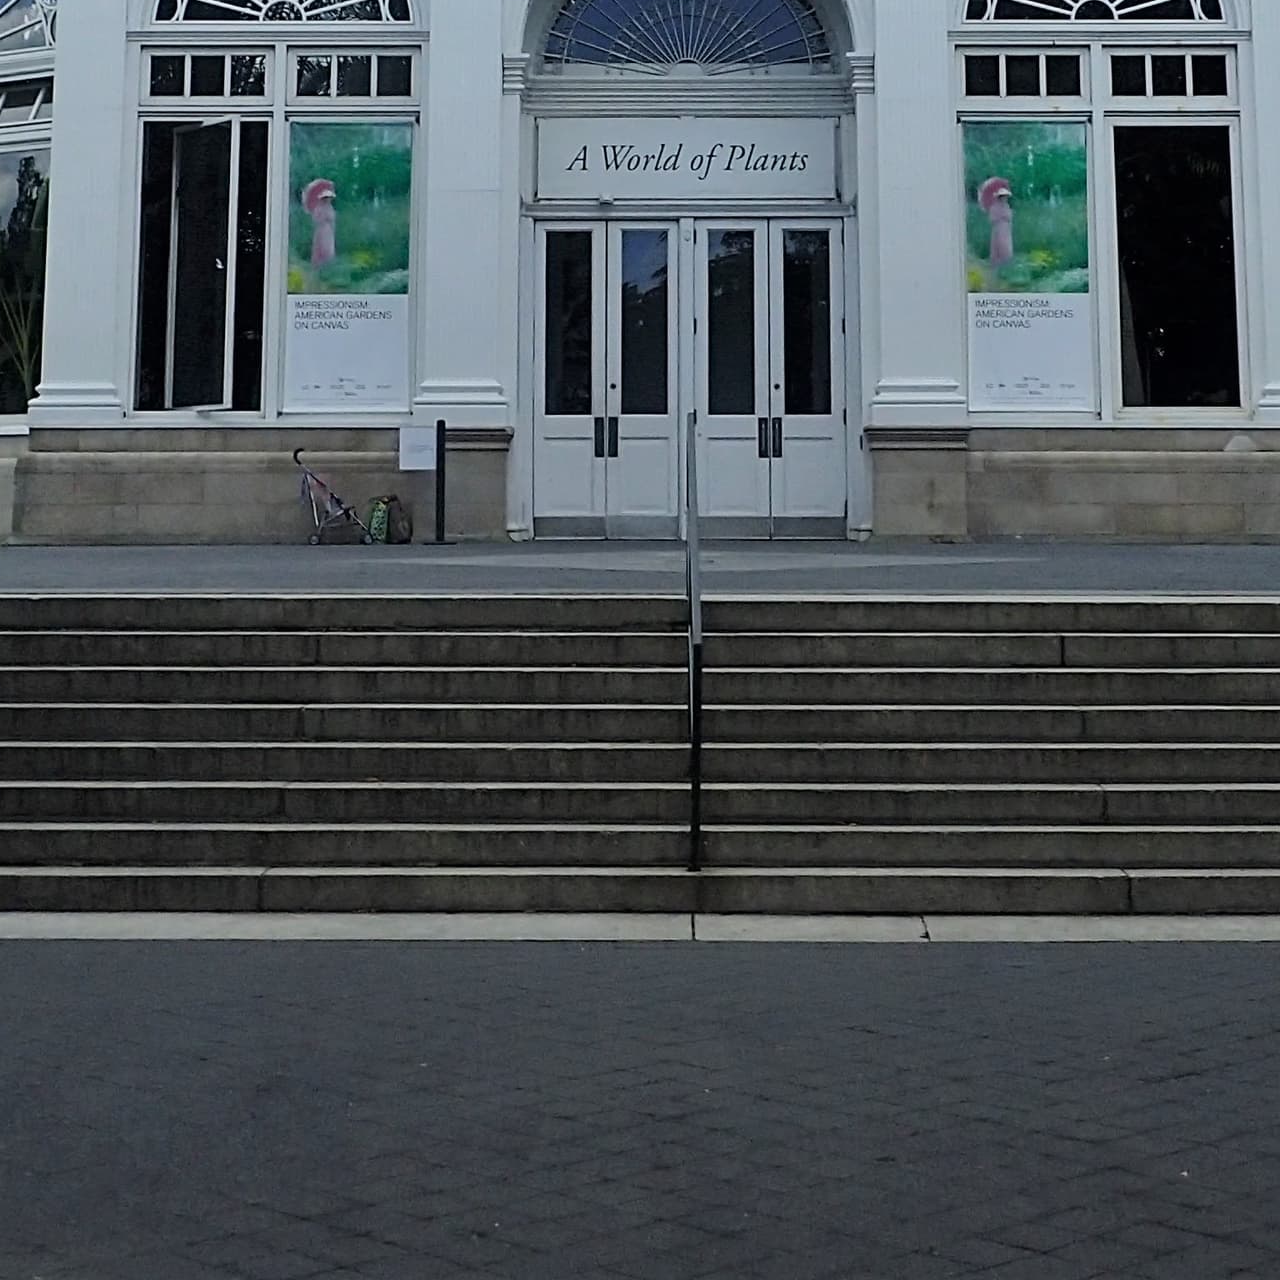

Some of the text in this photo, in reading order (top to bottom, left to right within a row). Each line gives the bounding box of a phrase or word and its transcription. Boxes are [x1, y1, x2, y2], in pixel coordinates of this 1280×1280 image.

[565, 143, 809, 180] A World of Plants
[294, 310, 393, 320] AMERICAN GARDENS
[975, 309, 1074, 319] AMERICAN GARDENS
[294, 320, 350, 330] ON CANVAS
[975, 319, 1032, 329] ON CANVAS
